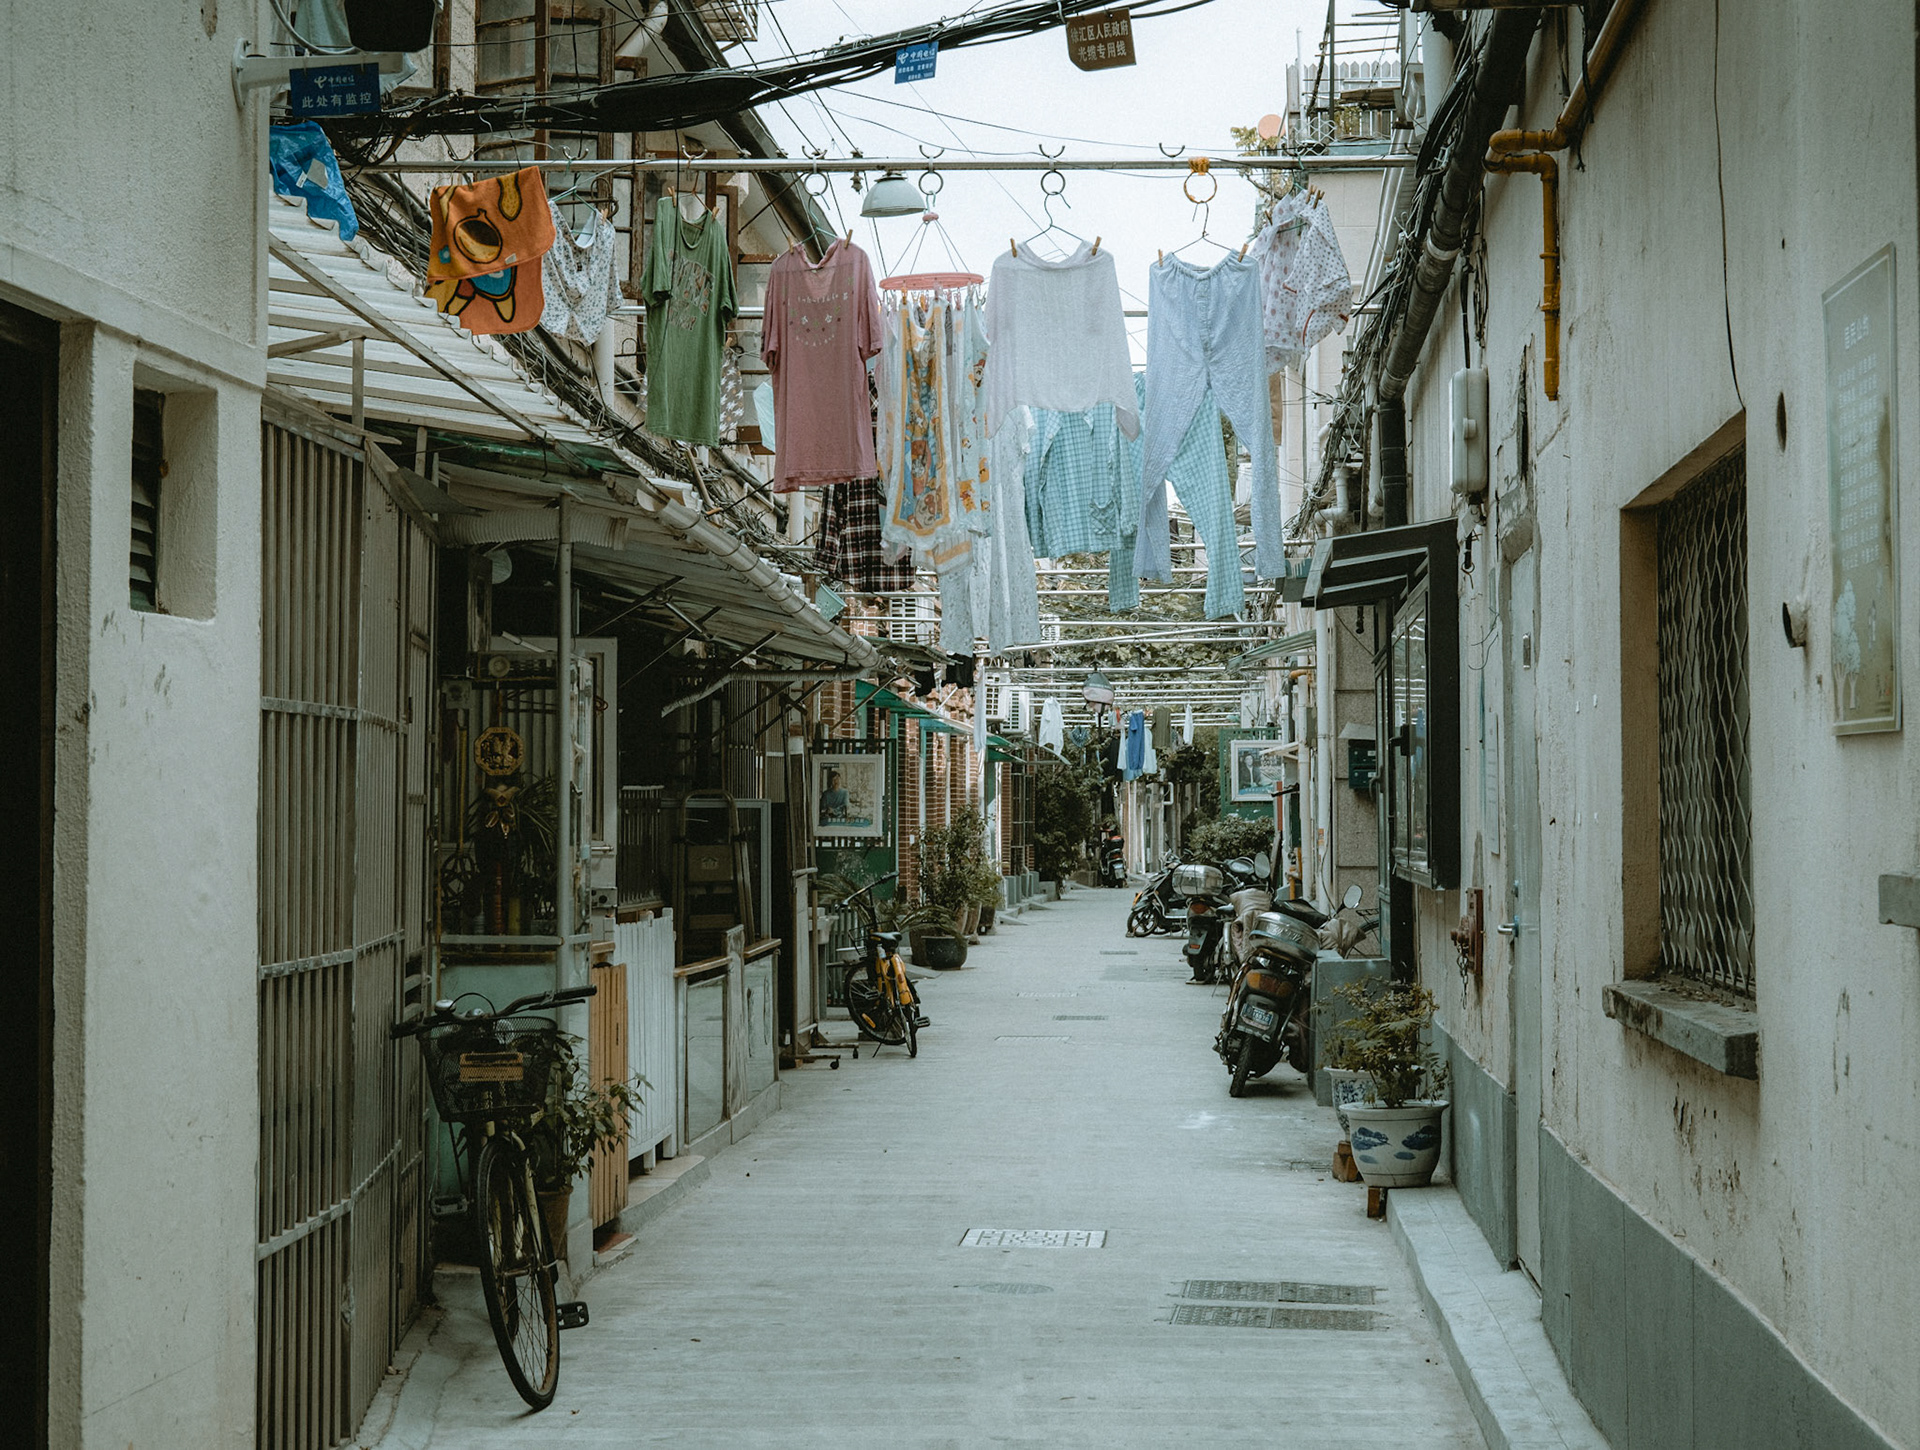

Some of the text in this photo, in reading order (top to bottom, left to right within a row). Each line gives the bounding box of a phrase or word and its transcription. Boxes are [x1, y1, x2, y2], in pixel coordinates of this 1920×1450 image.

[1070, 19, 1129, 44] 徐汇区人民政府
[1078, 40, 1127, 62] 光缆专用线
[301, 92, 373, 109] 此处有监控
